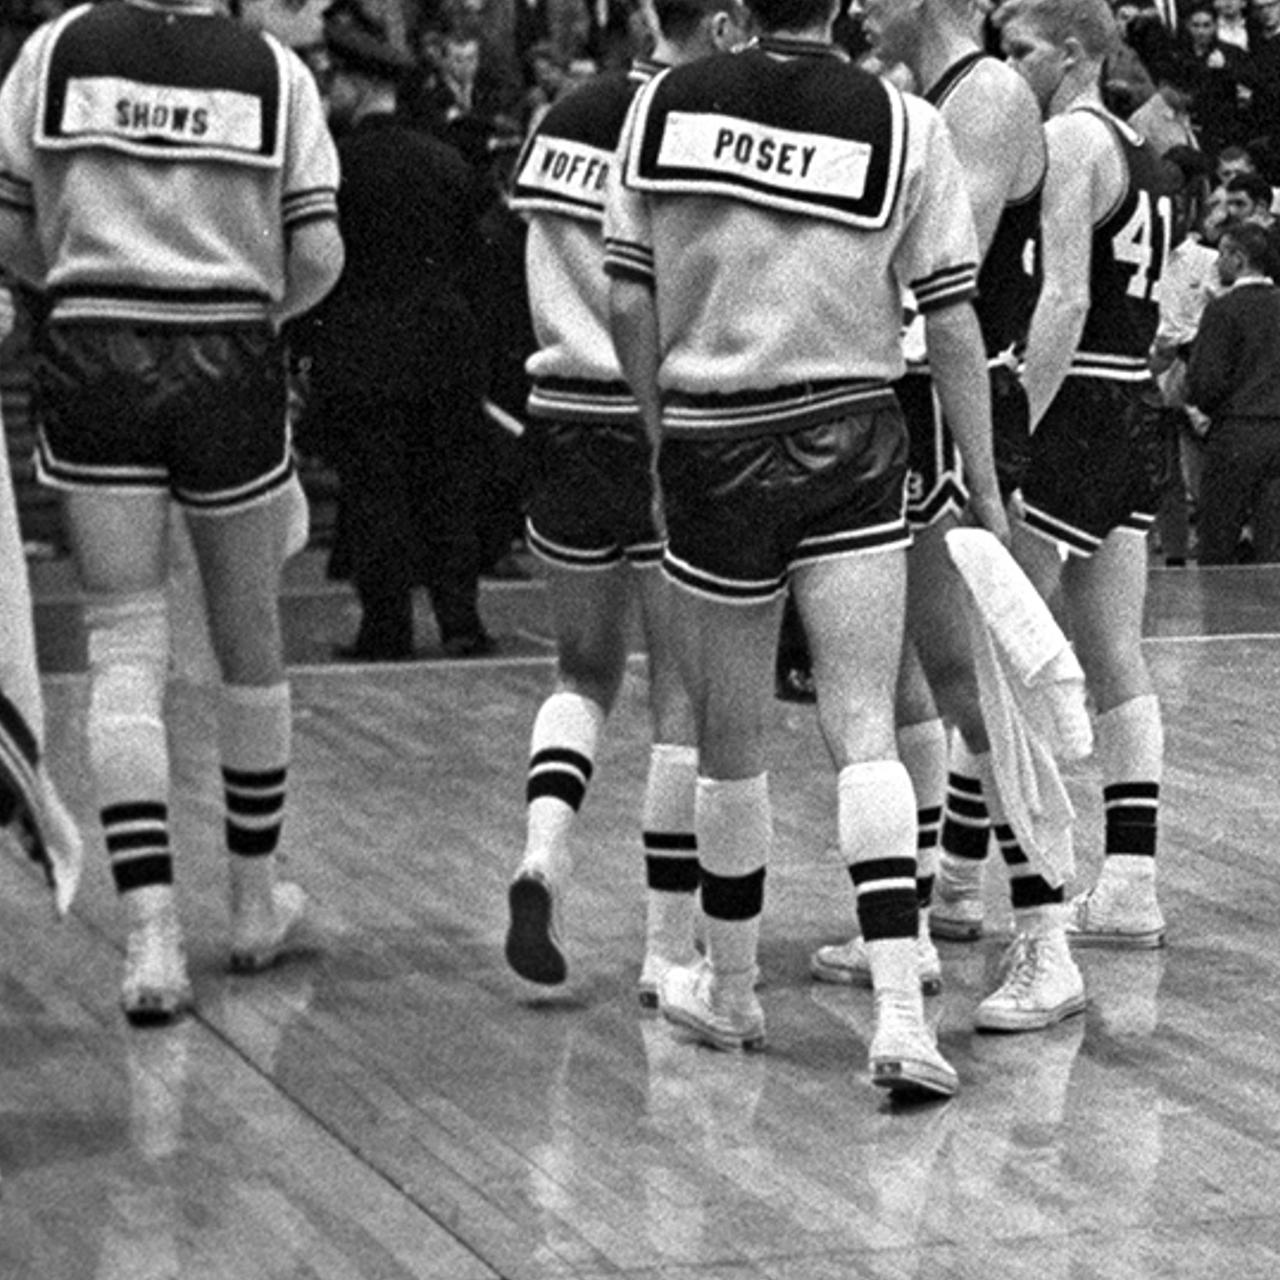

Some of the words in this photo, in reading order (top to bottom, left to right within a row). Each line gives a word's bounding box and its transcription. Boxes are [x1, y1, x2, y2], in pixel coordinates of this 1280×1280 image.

[116, 97, 208, 136] SHOWS
[713, 128, 815, 178] POSEY
[1112, 189, 1171, 303] 41
